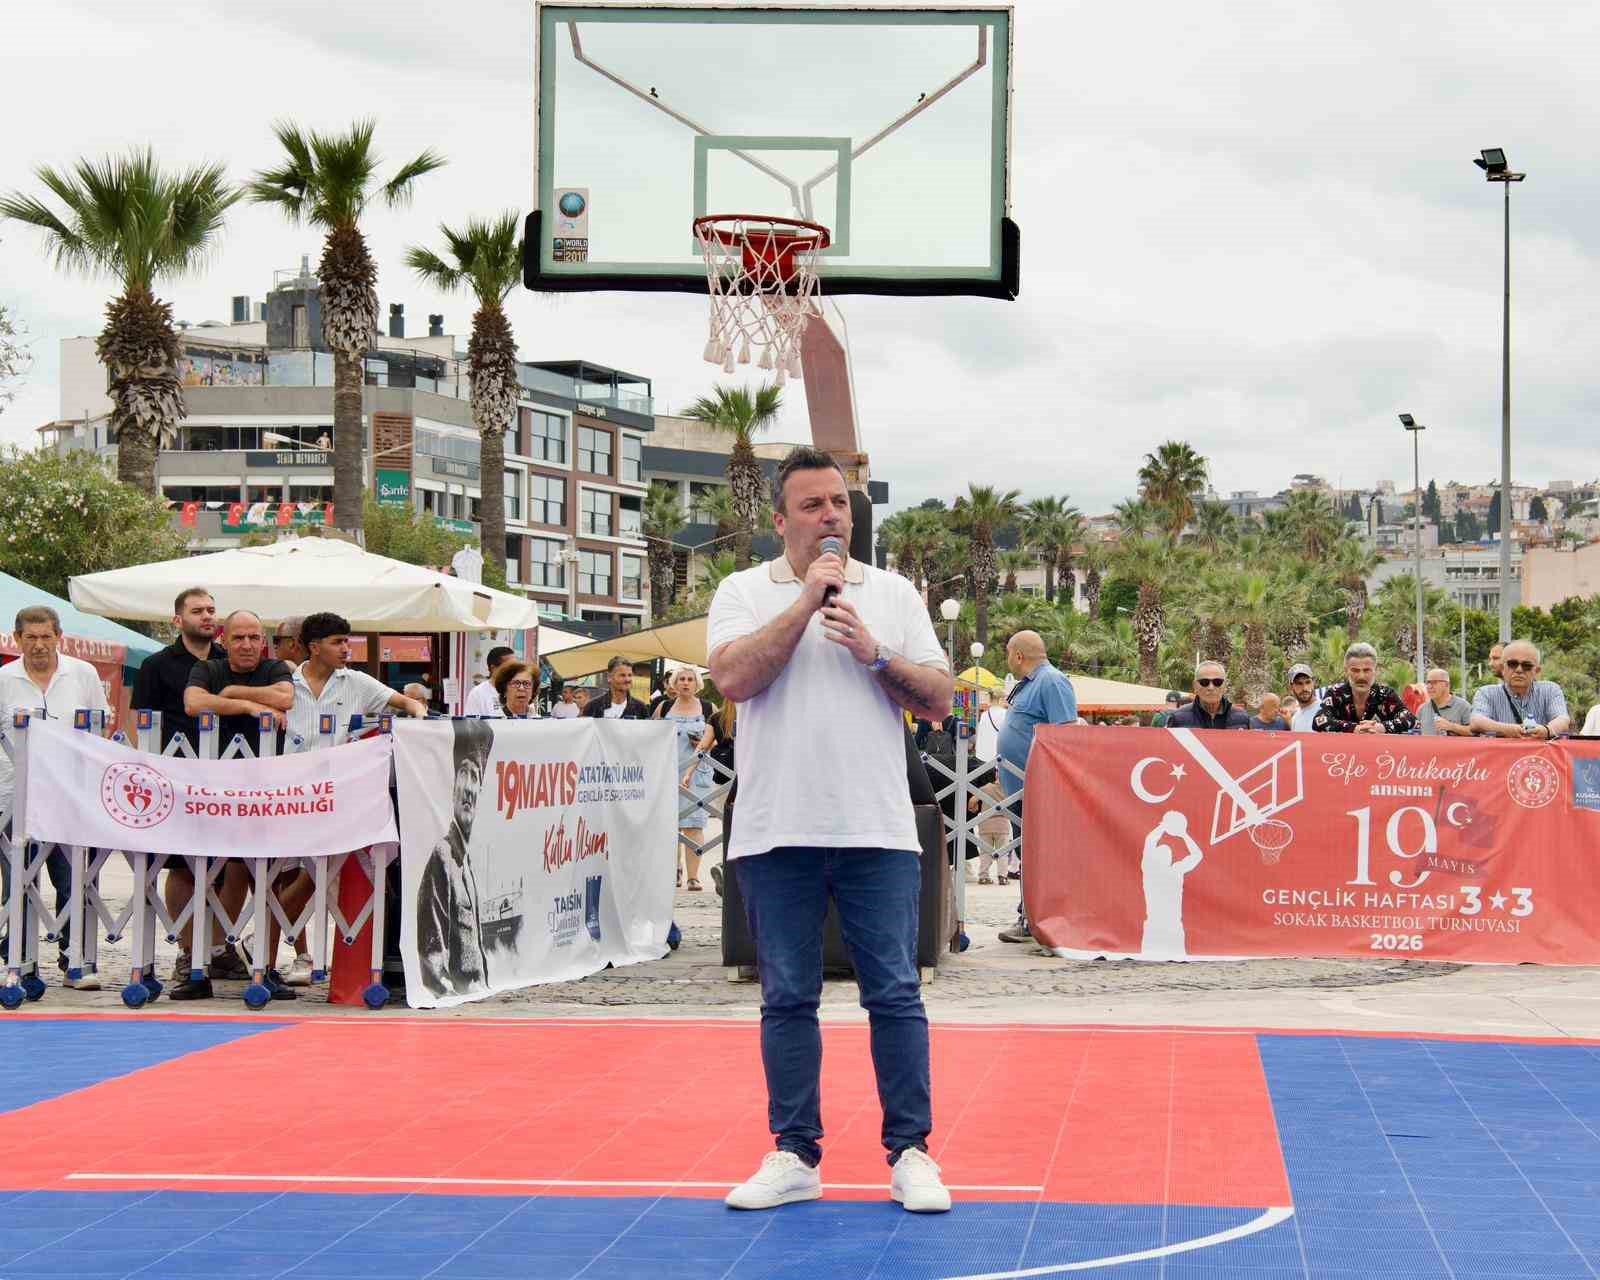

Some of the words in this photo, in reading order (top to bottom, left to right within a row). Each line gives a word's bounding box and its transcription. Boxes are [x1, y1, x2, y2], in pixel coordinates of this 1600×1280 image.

[566, 250, 587, 262] 2010
[1321, 752, 1368, 785] Efe
[311, 781, 335, 795] VE
[185, 801, 232, 816] SPOR
[237, 797, 335, 817] BAKANLIĞI
[543, 813, 572, 873] Kutlu
[1345, 804, 1438, 888] 19
[1427, 856, 1475, 874] MAYIS
[1262, 887, 1356, 911] GENÇLİK
[1364, 892, 1455, 910] HAFTASI
[1459, 886, 1482, 915] 3
[1510, 887, 1534, 917] 3
[1273, 912, 1328, 928] SOKAK
[1331, 915, 1424, 931] BASKETBOL
[1428, 916, 1521, 934] TURNUVASI
[1369, 933, 1423, 950] 2026
